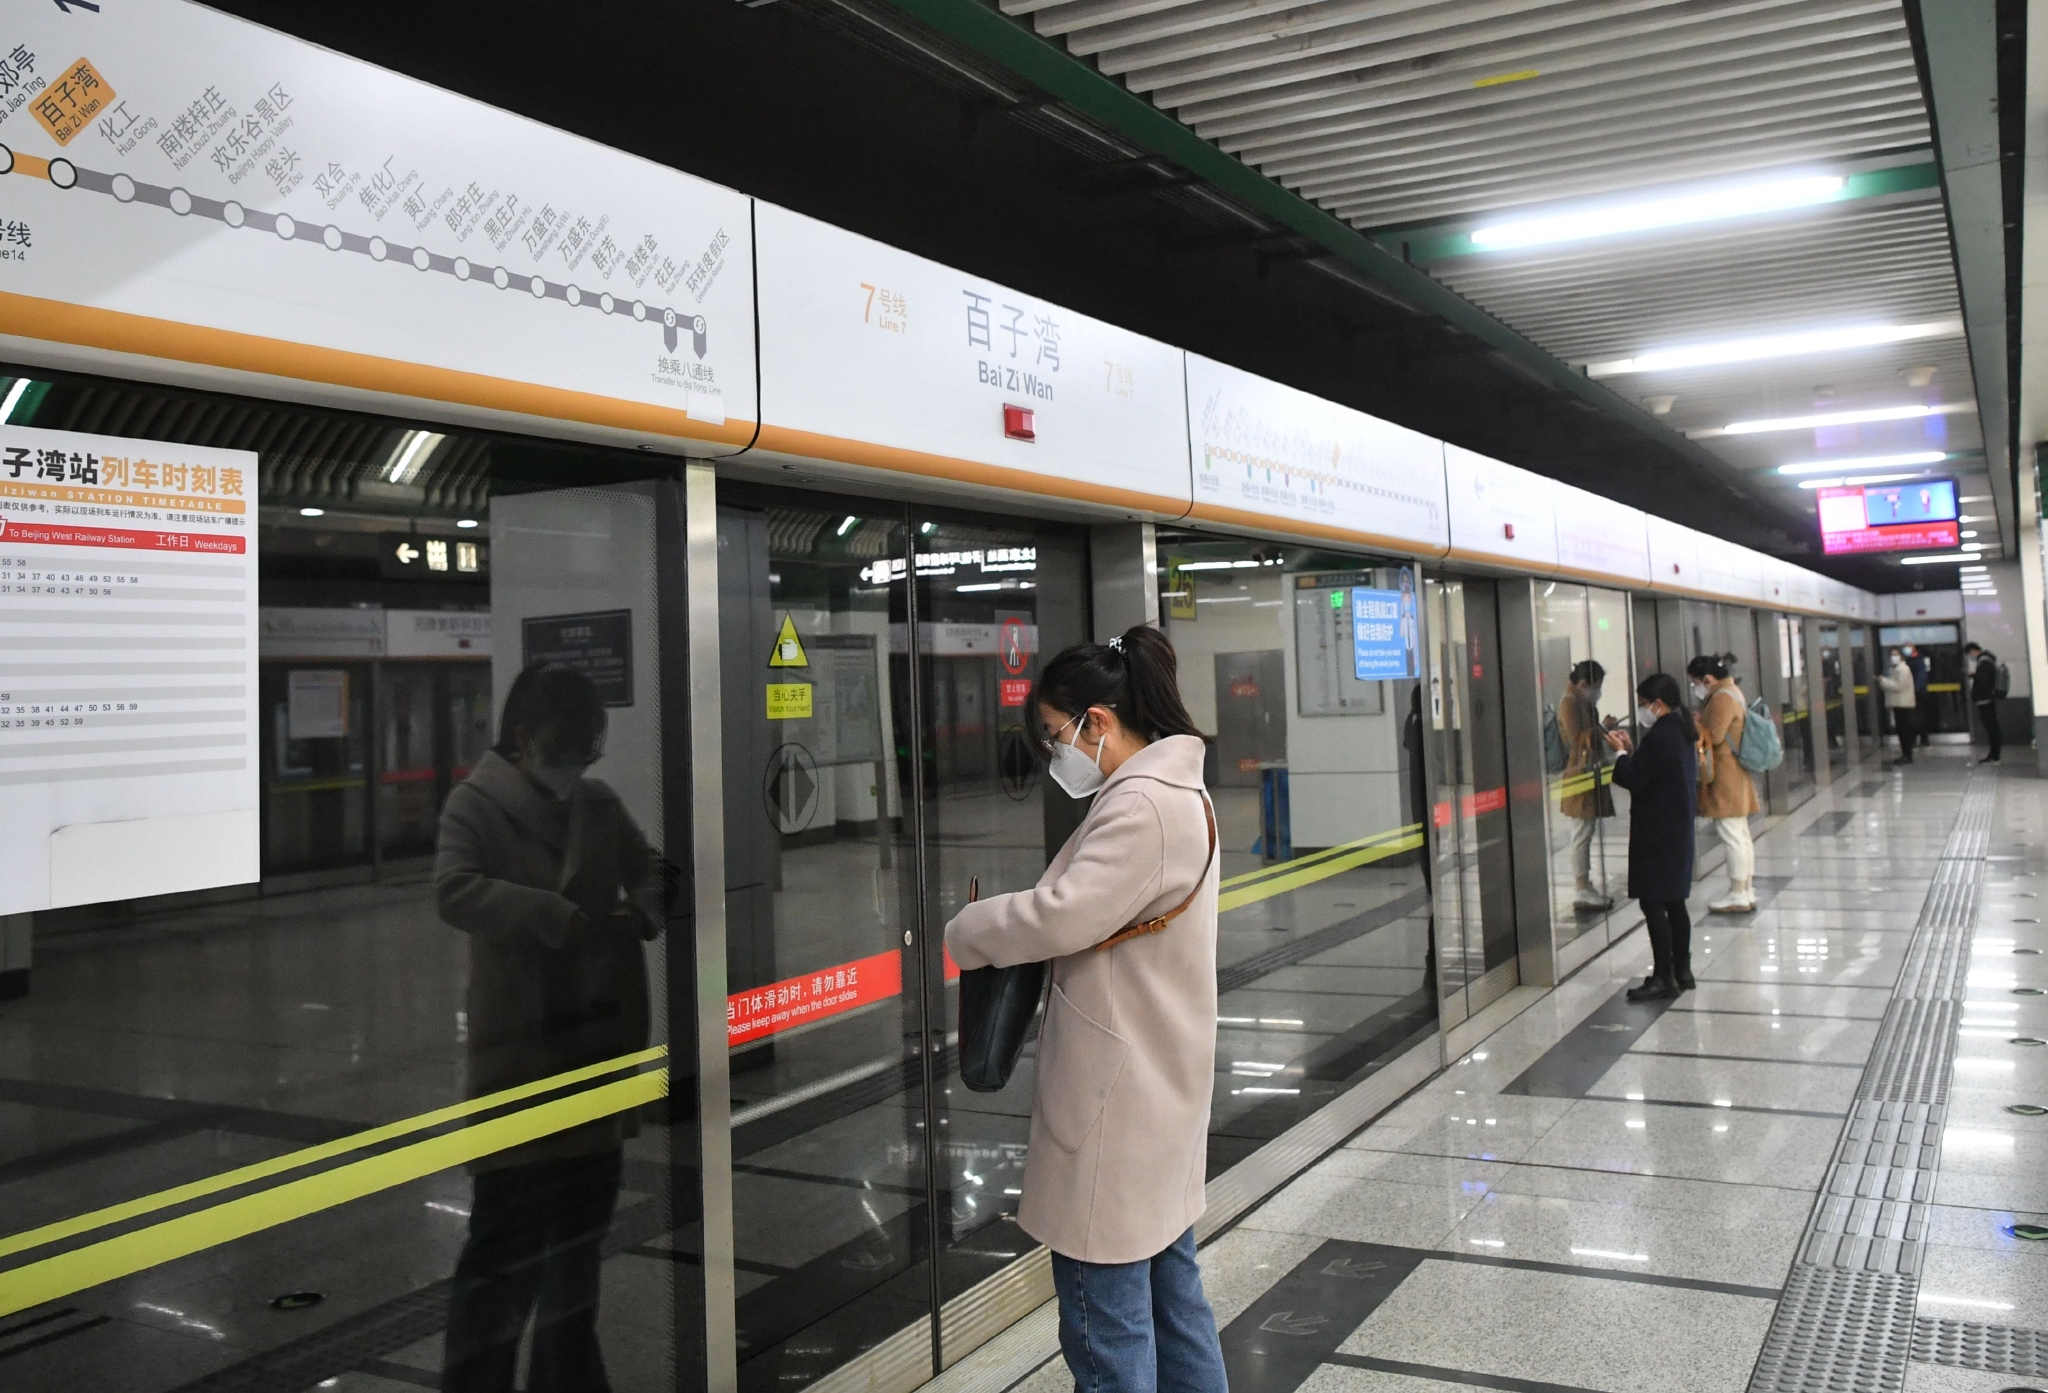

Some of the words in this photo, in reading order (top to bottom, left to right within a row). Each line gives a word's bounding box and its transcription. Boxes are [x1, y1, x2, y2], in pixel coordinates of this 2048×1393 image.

[0, 44, 35, 99] 郊亭
[6, 93, 26, 113] Jiao
[22, 76, 47, 96] Ting
[35, 65, 99, 127] 百子湾
[55, 123, 73, 141] Bai
[69, 113, 82, 128] Zi
[78, 98, 101, 118] Wan
[98, 100, 140, 145] 化工
[116, 137, 136, 157] Hua
[133, 117, 158, 139] Gong
[156, 85, 226, 159] 南楼梓庄
[173, 153, 192, 171] Nan
[188, 131, 211, 155] Louzi
[207, 106, 237, 136] Zhuang
[210, 82, 293, 173] 欢乐谷景区
[228, 158, 255, 185] Beijing
[250, 136, 275, 161] Happy
[270, 115, 294, 137] Valley
[265, 146, 301, 187] 垡头
[279, 185, 292, 198] Fa
[287, 172, 304, 187] Tou
[312, 162, 345, 200] 双合
[326, 182, 354, 210] Shuang
[349, 171, 361, 185] He
[359, 154, 396, 213] 焦化厂
[373, 205, 388, 222] Jiao
[384, 191, 400, 207] Hua
[396, 169, 419, 193] Chang
[402, 182, 426, 222] 黄厂
[415, 208, 437, 232] Huang
[433, 187, 454, 210] Chang
[445, 181, 485, 232] 郎辛庄
[456, 224, 474, 243] Lang
[468, 213, 480, 227] Xin
[477, 189, 500, 215] Zhuang
[483, 193, 518, 243] 黑庄户
[495, 238, 507, 253] Hei
[503, 215, 526, 241] Zhuang
[521, 206, 532, 218] Hu
[521, 203, 557, 253] 万盛西
[532, 229, 559, 262] Wansheng
[557, 215, 591, 263] 万盛东
[568, 239, 593, 271] Wansheng
[591, 234, 617, 271] 群芳
[602, 266, 614, 280] Qun
[611, 250, 626, 268] Fang
[624, 234, 658, 280] 高楼金
[654, 256, 676, 288] 花庄
[686, 227, 730, 294] 环球度假区
[635, 274, 646, 289] Gao
[643, 263, 654, 276] Lou
[665, 281, 676, 296] Hua
[673, 260, 691, 284] Zhuang
[695, 275, 713, 304] Universal
[711, 258, 725, 278] Resort
[860, 282, 876, 324] 7
[878, 288, 907, 318] 号线
[879, 315, 899, 332] Line
[901, 322, 906, 334] 7
[963, 289, 1061, 372] 百子湾
[651, 373, 675, 386] Transfer
[677, 379, 683, 388] to
[709, 385, 722, 394] Line
[657, 355, 714, 383] 换乘八通线
[979, 360, 1002, 388] Bai
[1006, 367, 1020, 392] Zi
[1023, 372, 1053, 401] Wan
[67, 490, 134, 505] STATION
[143, 496, 223, 510] TIMETABLE
[9, 529, 19, 537] To
[21, 529, 50, 541] Beijing
[52, 531, 73, 540] West
[75, 533, 106, 543] Railway
[108, 535, 135, 544] Station
[156, 535, 188, 548] 工作日
[195, 540, 238, 553] Weekdays
[17, 559, 26, 567] 58
[17, 572, 26, 580] 34
[1, 693, 10, 701] 59
[16, 706, 25, 714] 35
[31, 719, 40, 727] 39
[60, 718, 69, 726] 52
[752, 1015, 770, 1029] keep
[771, 1011, 790, 1024] away
[790, 1005, 810, 1017] when
[810, 1000, 822, 1011] the
[823, 995, 838, 1006] door
[838, 989, 858, 1003] slides
